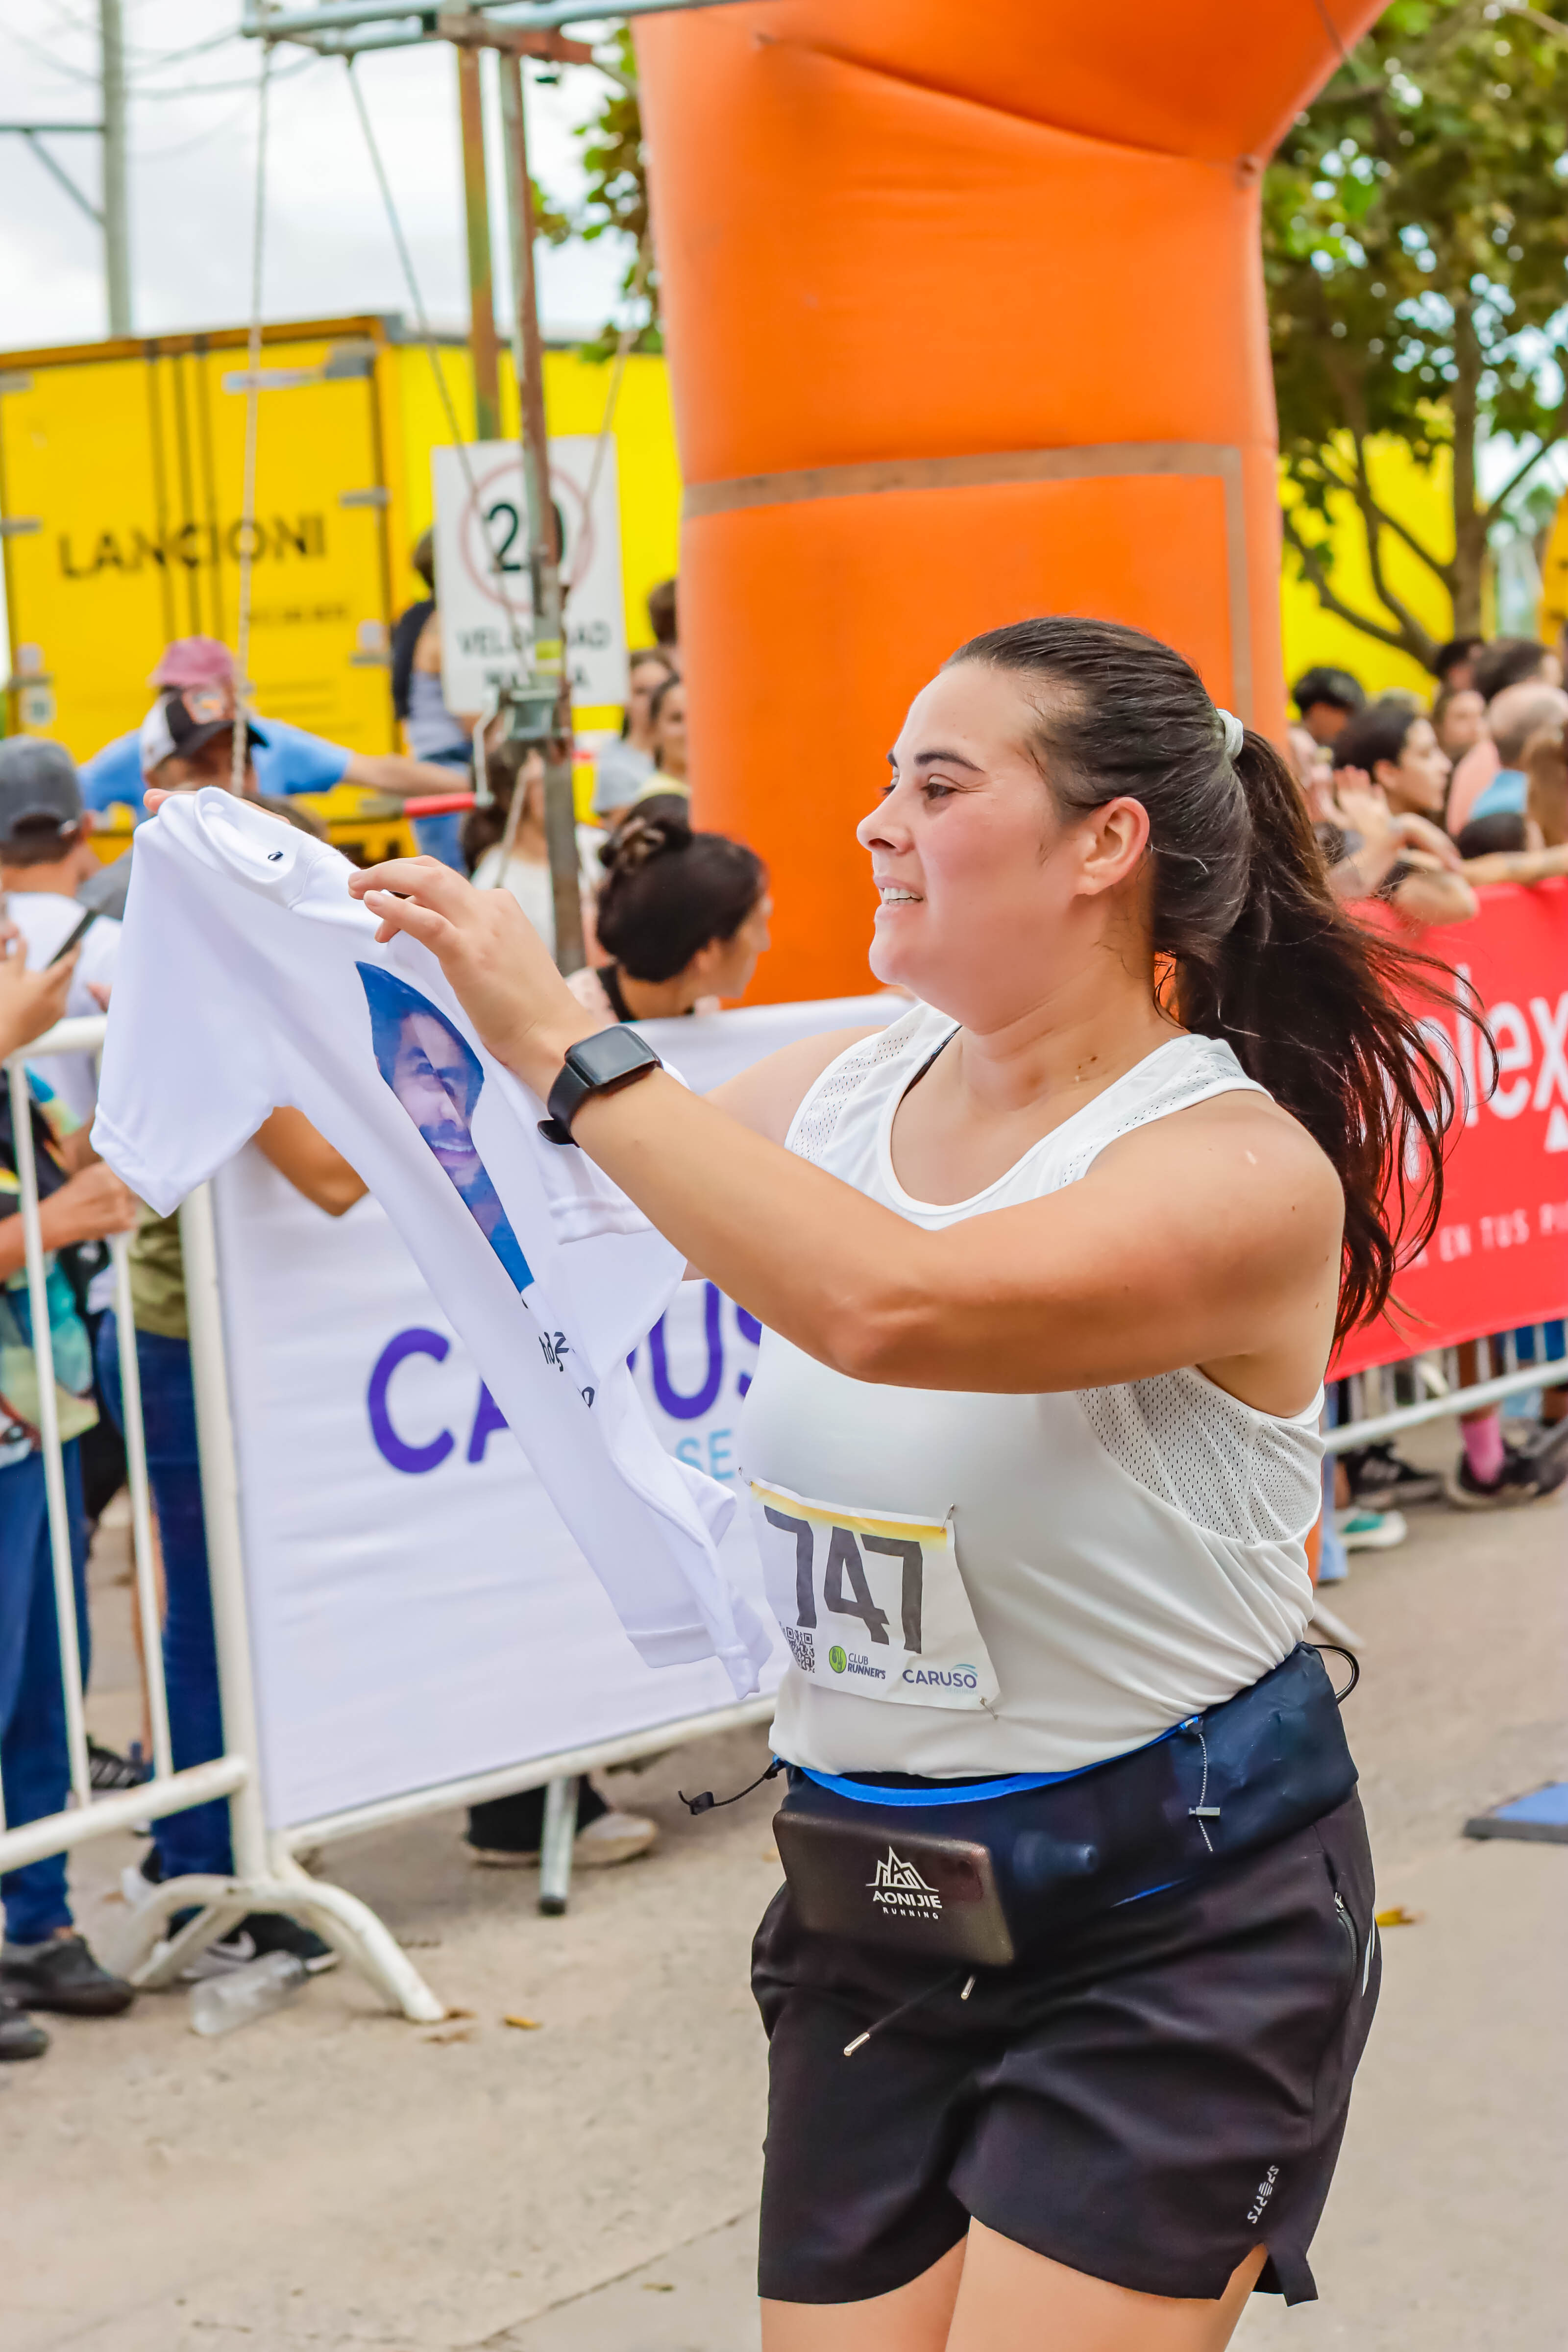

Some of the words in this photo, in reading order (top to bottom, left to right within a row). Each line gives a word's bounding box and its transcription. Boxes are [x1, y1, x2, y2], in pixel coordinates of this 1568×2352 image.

[57, 513, 326, 579] LANCIONI
[763, 1505, 923, 1654] 747
[848, 1653, 869, 1665] CLUB
[847, 1663, 886, 1680] RUNNER'S
[902, 1669, 978, 1689] CARUSO
[872, 1890, 943, 1909] AONIJIE
[882, 1906, 939, 1920] RUNNING
